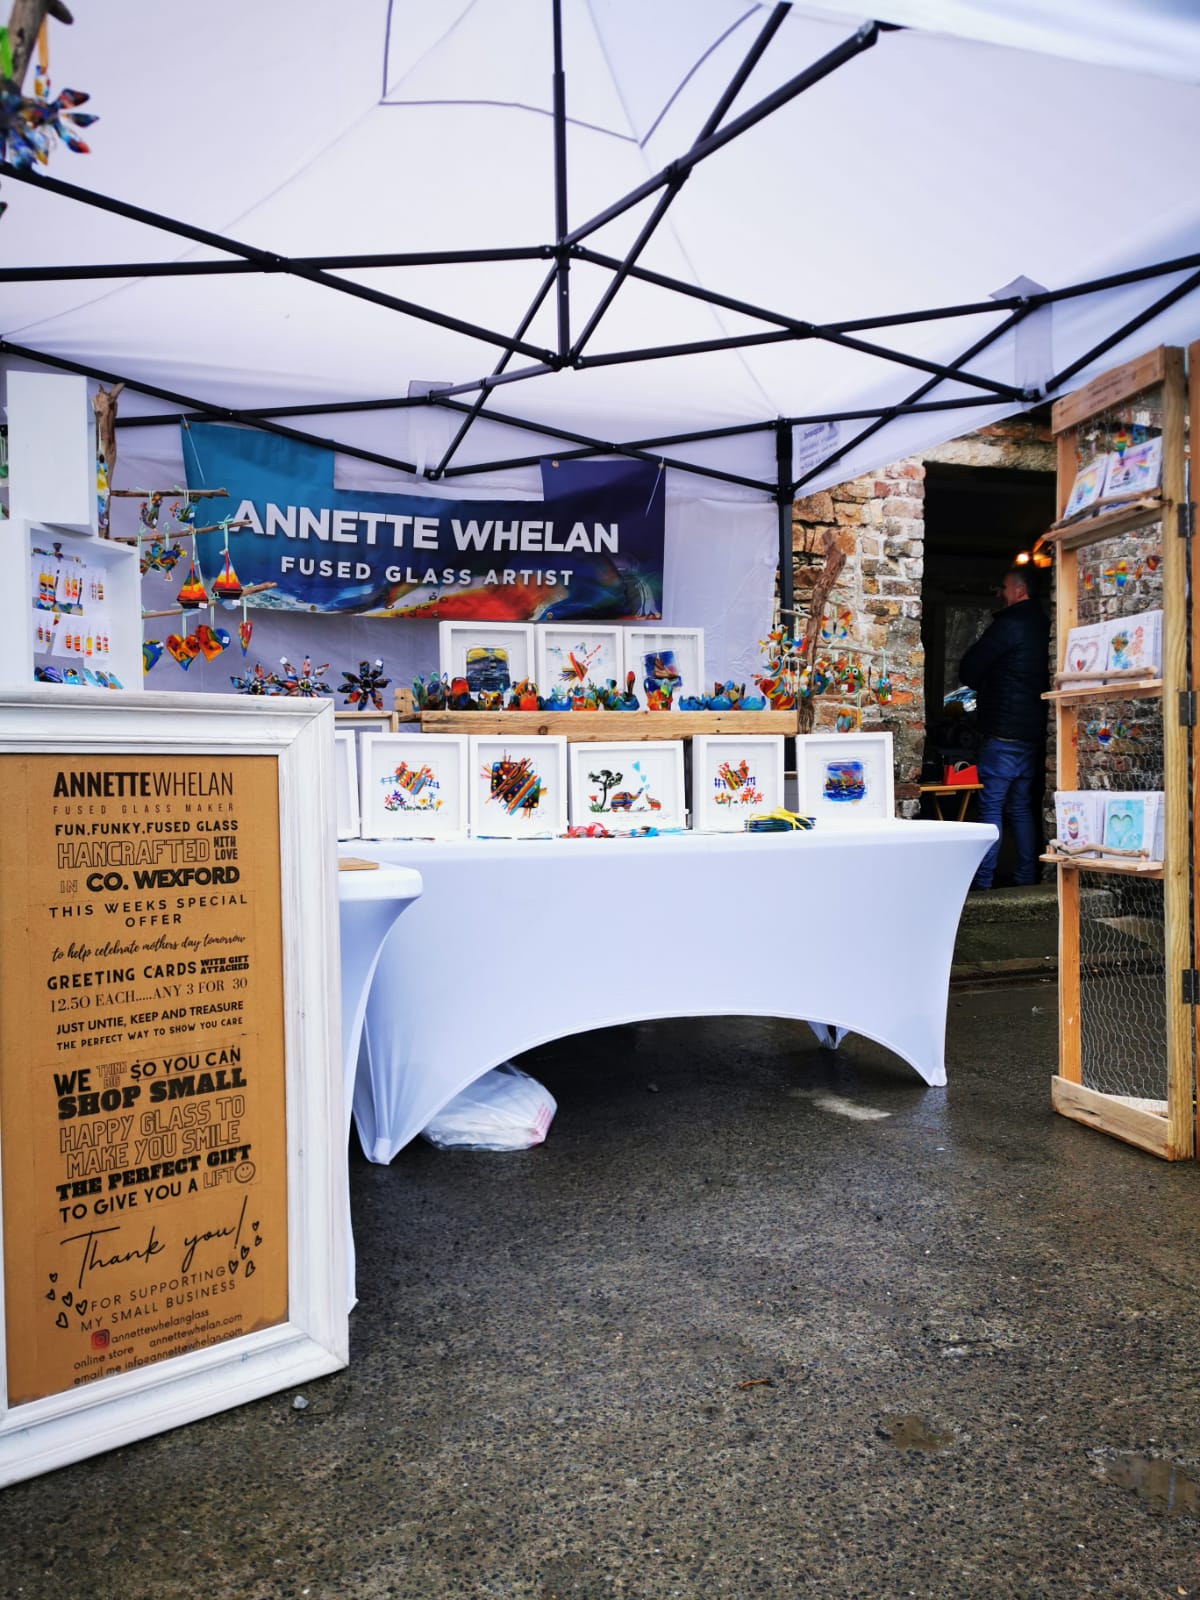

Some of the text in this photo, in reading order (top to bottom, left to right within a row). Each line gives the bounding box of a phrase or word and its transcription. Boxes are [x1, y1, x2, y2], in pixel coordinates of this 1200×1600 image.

[228, 500, 620, 554] ANNETTE WHELAN
[280, 556, 574, 587] FUSED GLASS ARTIST
[53, 802, 234, 815] FUSED GLASS MAKER
[196, 820, 239, 832] GLASS
[57, 838, 210, 869] HANCRAFTED
[215, 848, 239, 861] LOVE
[60, 866, 241, 893] IN CO. WEXFORD
[48, 895, 248, 918] THIS WEEKS SPECIAL
[125, 914, 182, 928] OFFER
[51, 933, 247, 963] to help celebrate mothers day tomorrow
[200, 955, 249, 967] WITH GIFT
[47, 961, 197, 990] GREETING CARDS
[200, 962, 250, 974] ATTACHED
[50, 996, 91, 1012] 12.50
[186, 982, 194, 995] 3
[198, 979, 225, 993] FOR
[232, 977, 248, 990] 30
[56, 1000, 244, 1035] JUST UNTIE, KEEP AND TREASURE
[57, 1016, 243, 1051] THE PERFECT WAY TO SHOW YOU CARE
[96, 1061, 128, 1078] THINK
[130, 1047, 241, 1080] SO YOU CAN
[53, 1068, 91, 1097] WE
[58, 1068, 247, 1120] SHOP SMALL
[103, 1075, 121, 1089] BIG
[60, 1095, 246, 1153] HAPPY GLASS TO
[66, 1120, 241, 1179] MAKE YOU SMILE
[56, 1144, 251, 1202] THE PERFECT GIFT
[59, 1166, 235, 1223] TO GIVE YOU A LIFT
[60, 1195, 248, 1289] Thank you!
[91, 1266, 226, 1312] FOR SUPPORTING
[80, 1280, 236, 1332] MY SMALL BUSINESS
[111, 1309, 209, 1344] annettewhelanglass
[74, 1314, 243, 1371] online store annettewhelan.com
[74, 1367, 104, 1385] email
[106, 1364, 122, 1375] me
